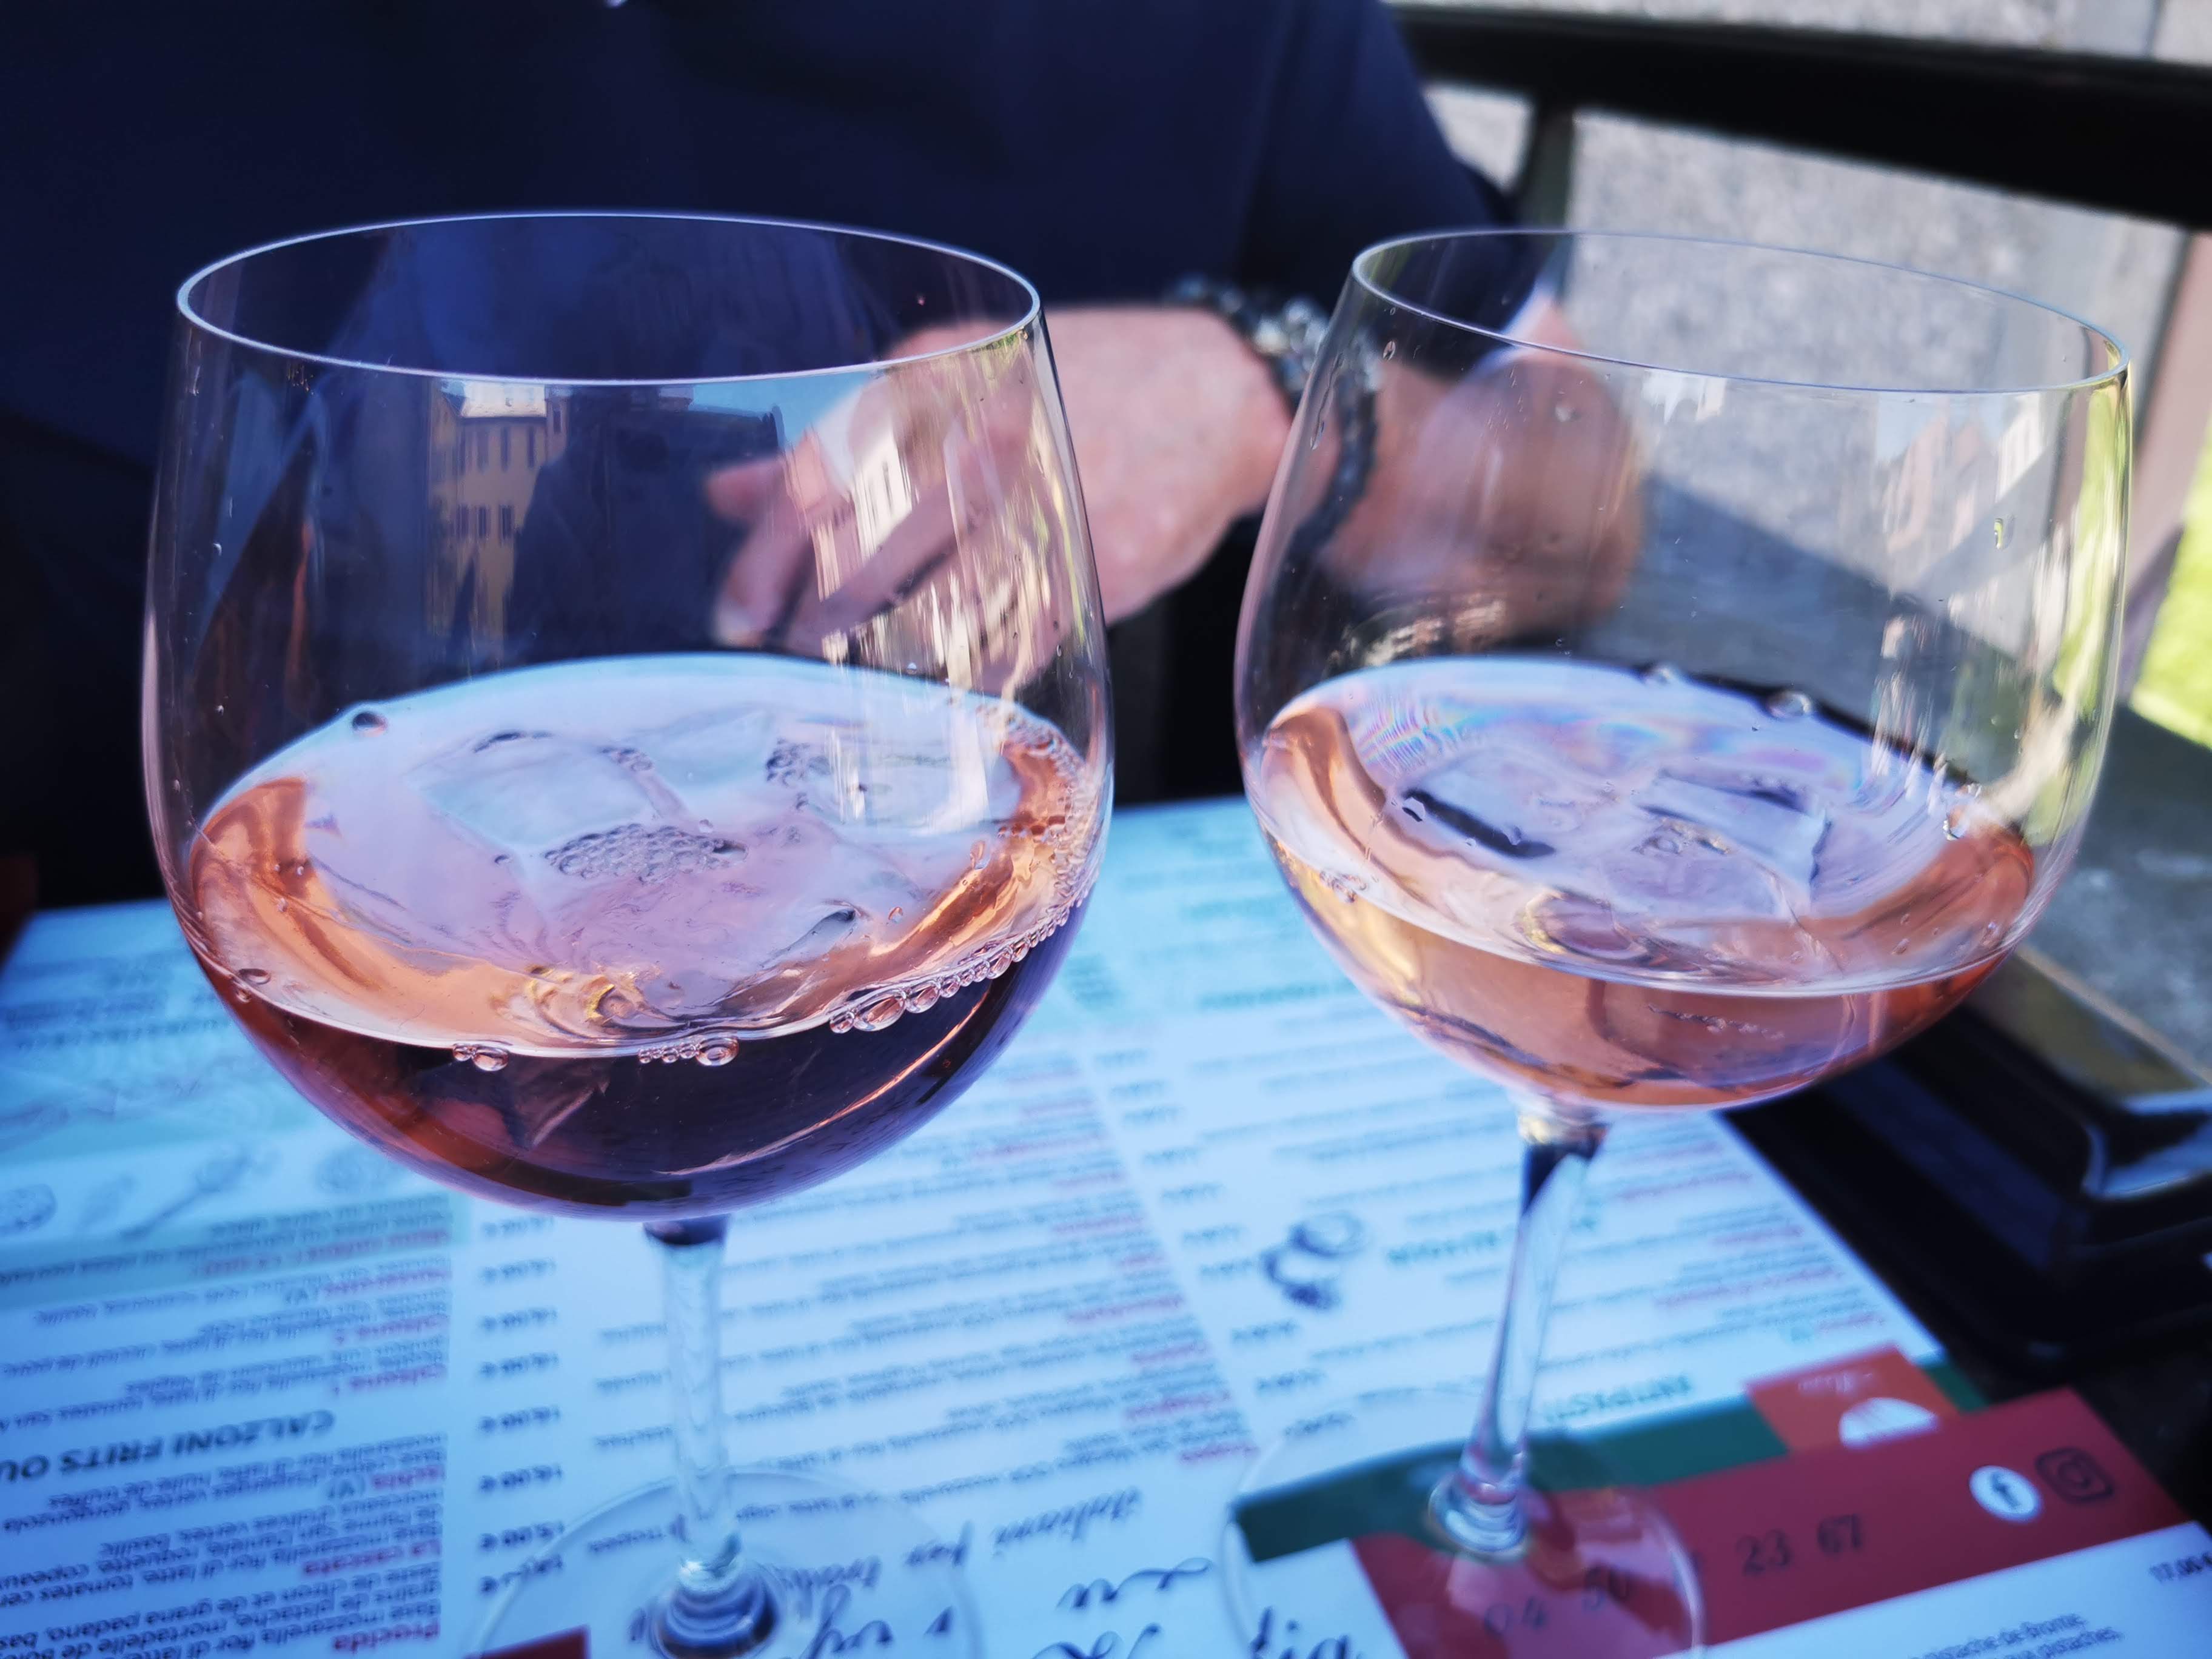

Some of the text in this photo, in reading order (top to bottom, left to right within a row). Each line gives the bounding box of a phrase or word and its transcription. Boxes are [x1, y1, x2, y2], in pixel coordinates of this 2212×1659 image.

[59, 1437, 164, 1473] FRITS
[173, 1411, 334, 1455] CALZONI
[1738, 1528, 1792, 1577] 23
[1818, 1513, 1863, 1556] 67
